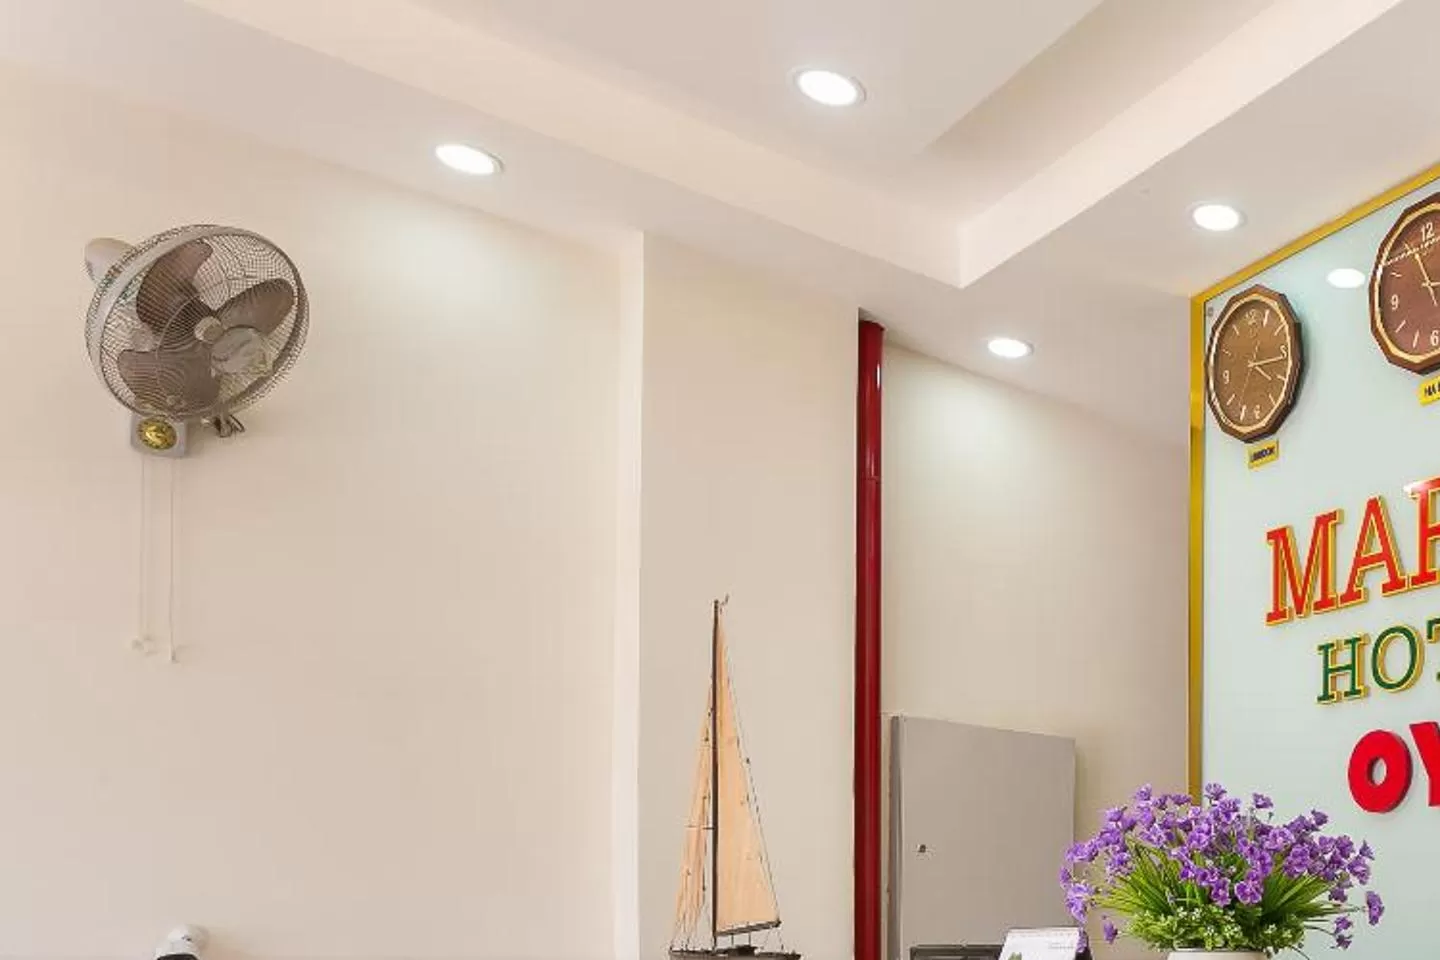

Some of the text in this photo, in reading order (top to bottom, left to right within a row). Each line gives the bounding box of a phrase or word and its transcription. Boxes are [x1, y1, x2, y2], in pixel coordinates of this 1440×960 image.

[1420, 222, 1433, 240] 12
[1391, 294, 1399, 310] 9
[1430, 330, 1439, 346] 6
[1222, 369, 1230, 384] 9
